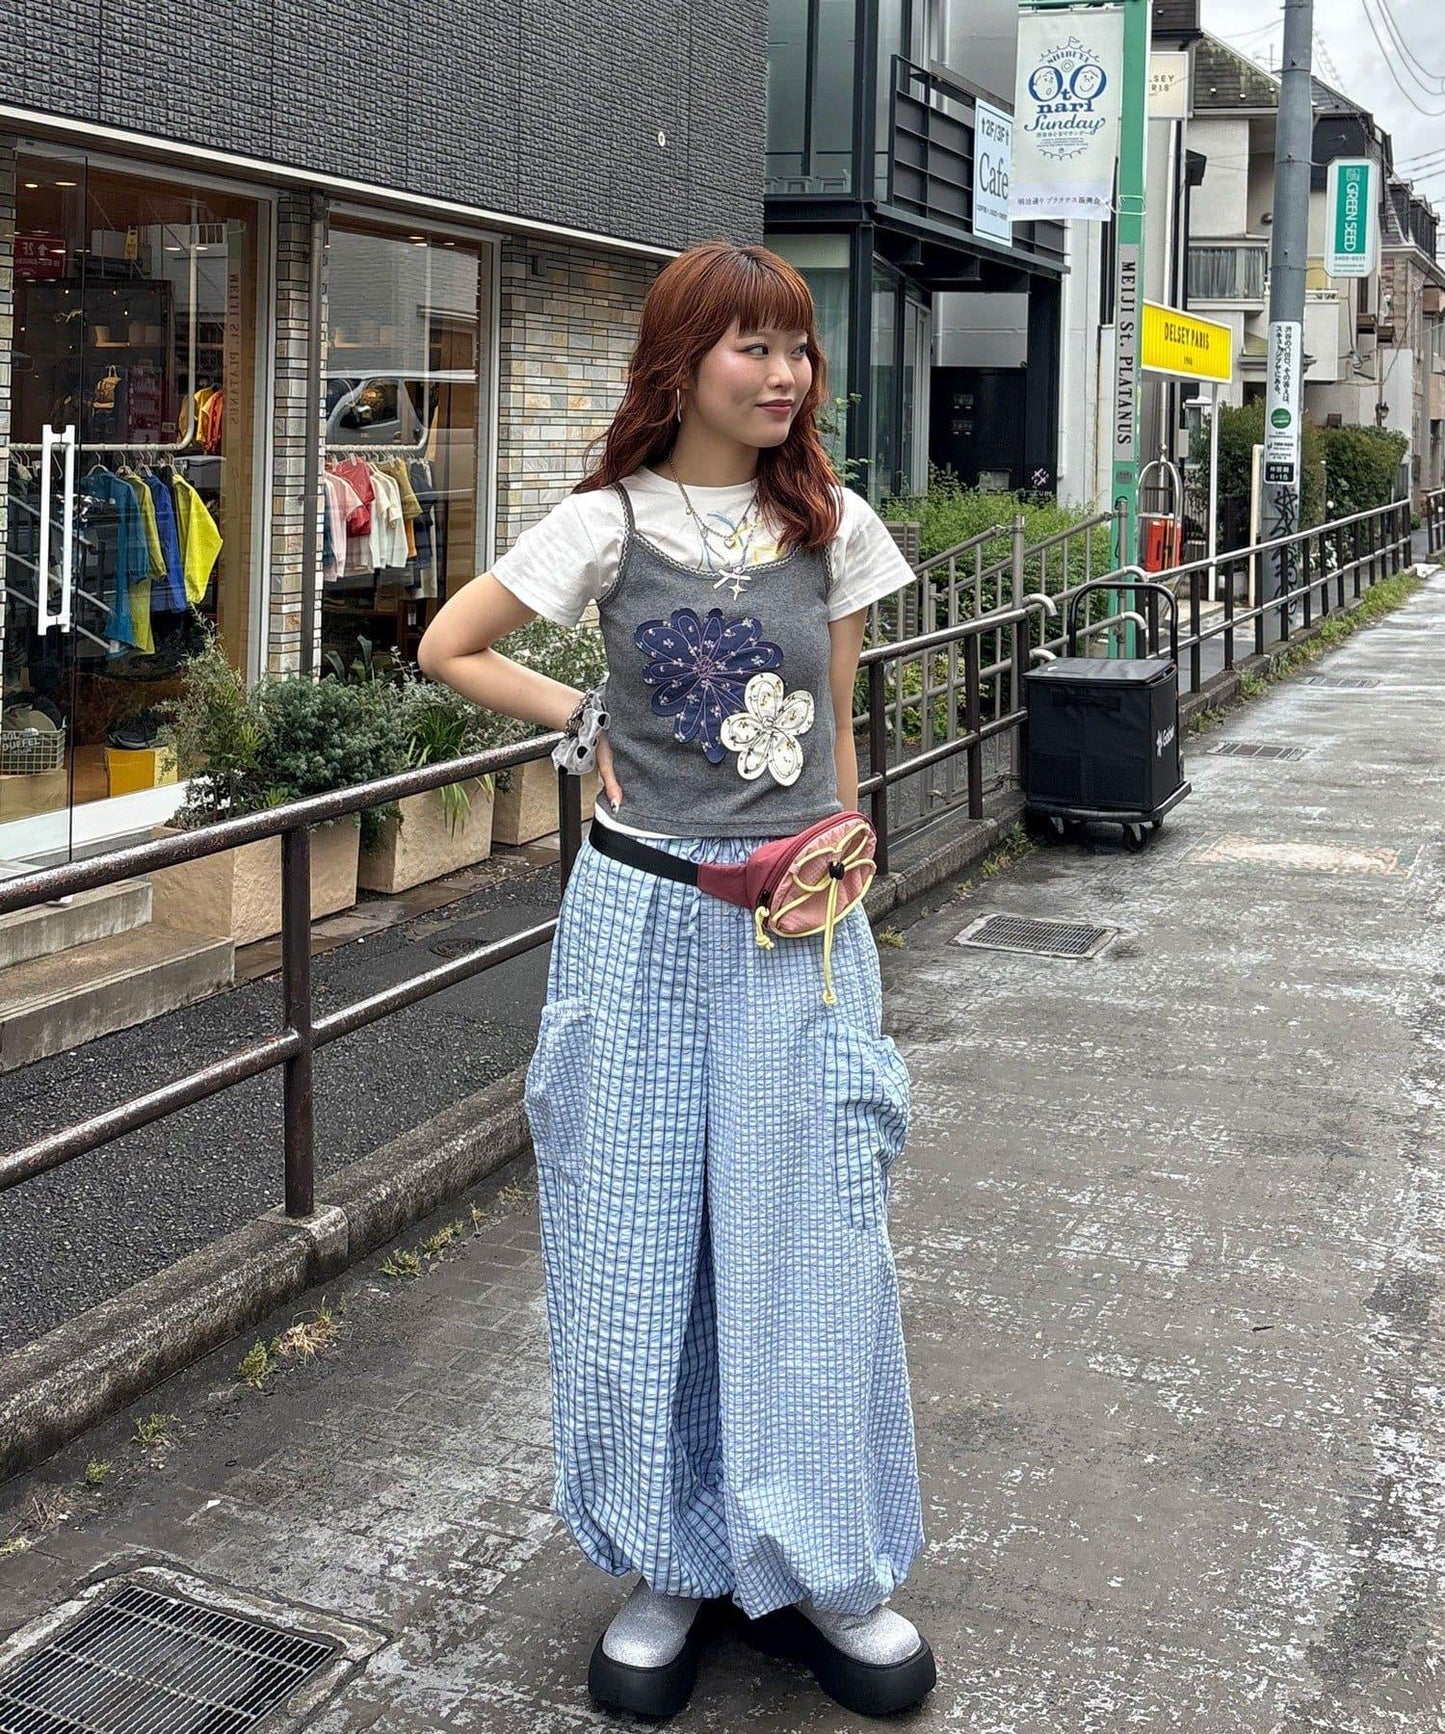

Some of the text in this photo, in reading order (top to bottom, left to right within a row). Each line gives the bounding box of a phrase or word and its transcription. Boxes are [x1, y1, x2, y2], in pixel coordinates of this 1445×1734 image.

[1024, 113, 1106, 135] Sunday
[1346, 182, 1359, 220] GREEN
[1344, 222, 1357, 252] SEED
[1164, 322, 1209, 351] DELSEY PARIS
[1117, 261, 1136, 445] MEIJI St. PLATANUS
